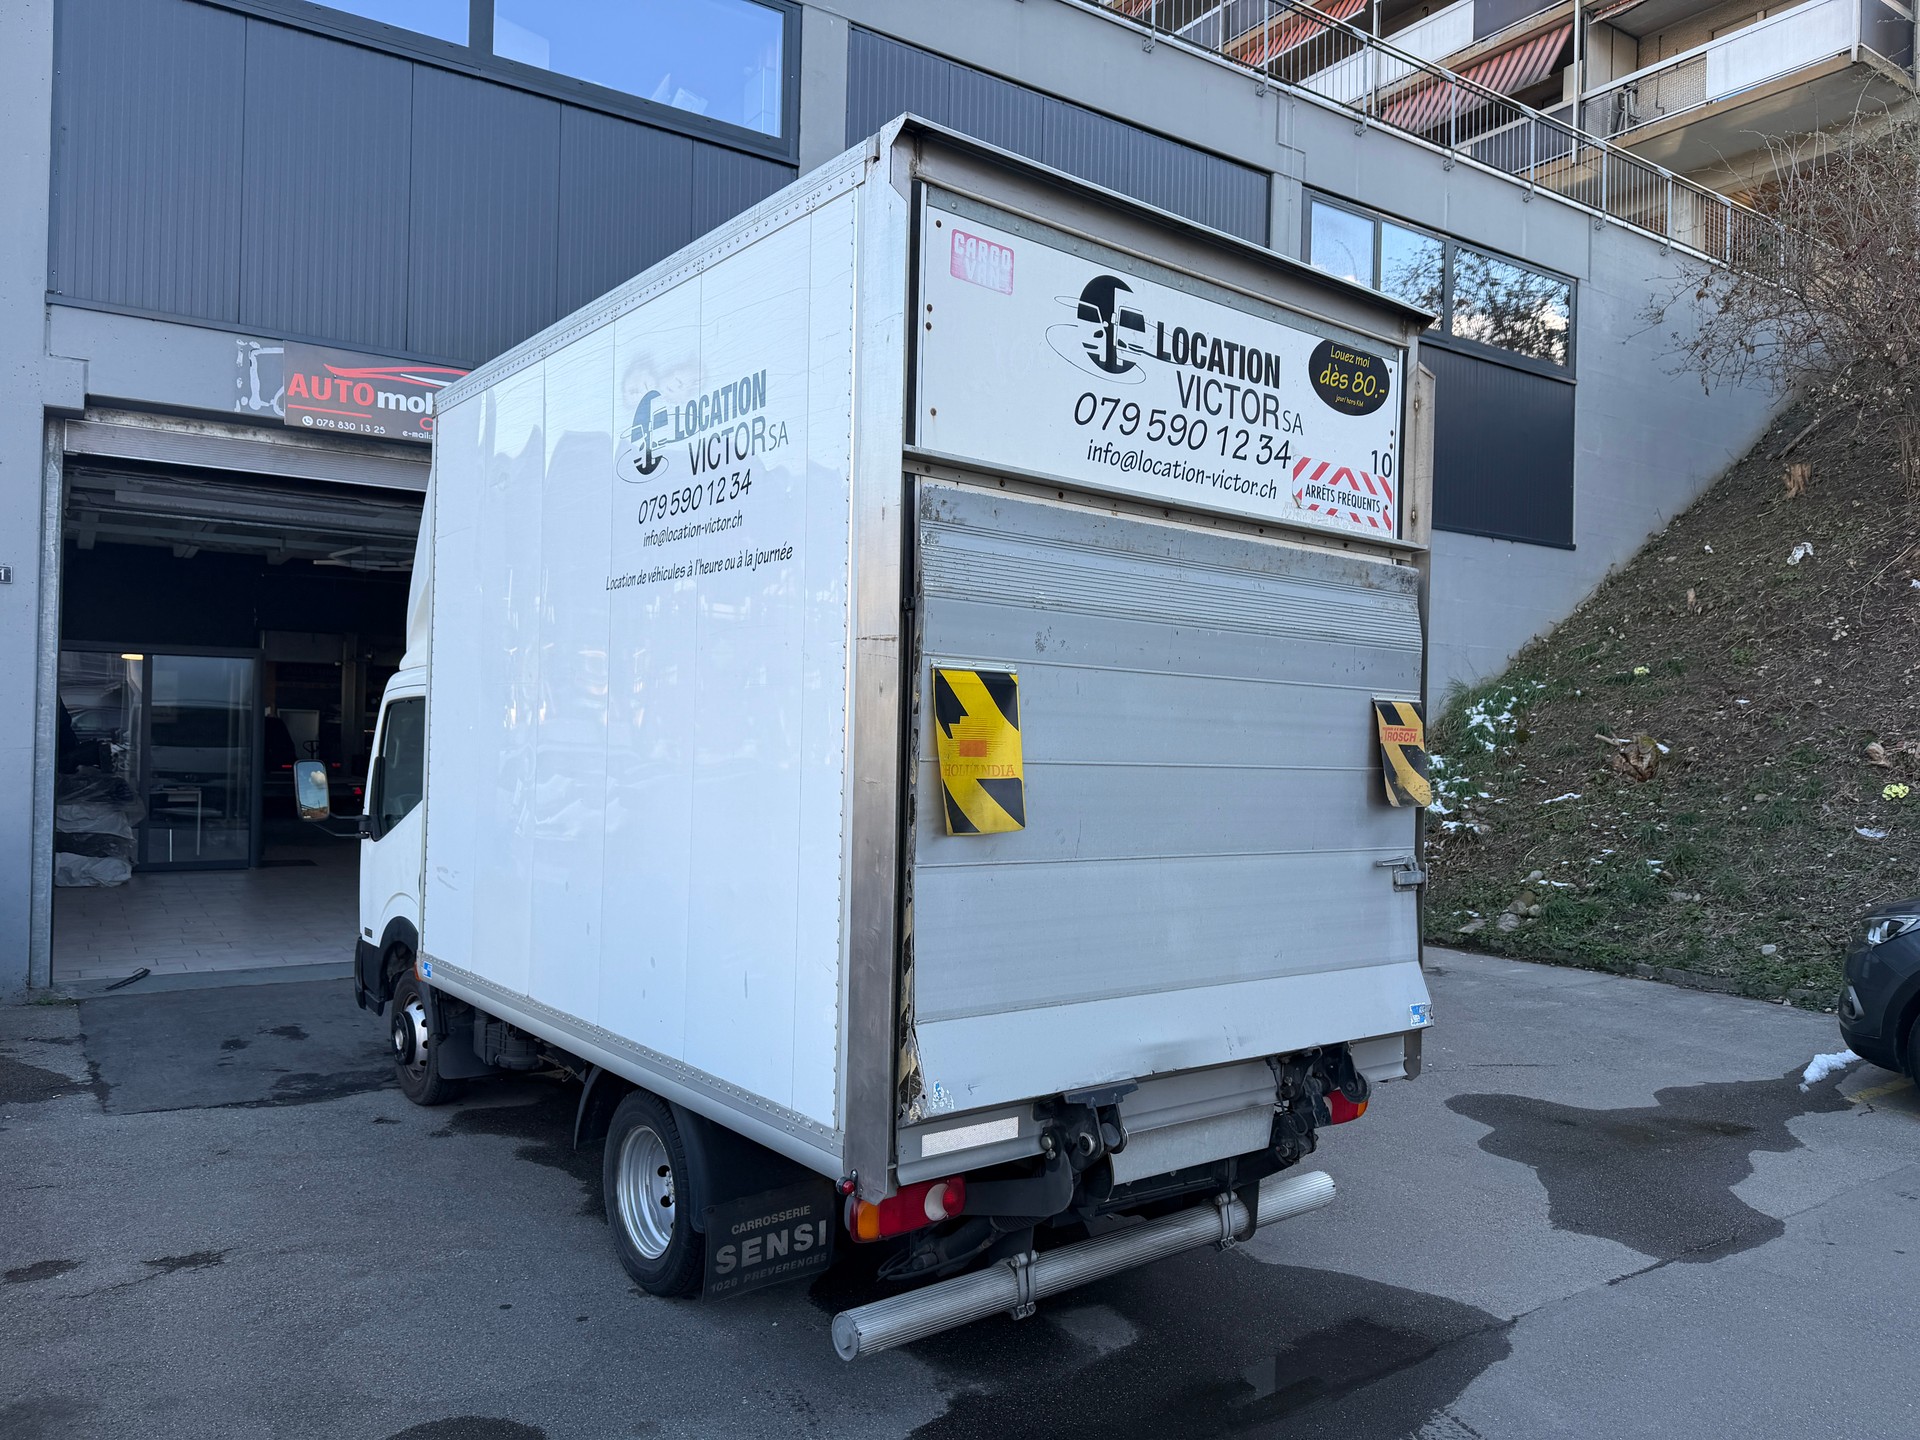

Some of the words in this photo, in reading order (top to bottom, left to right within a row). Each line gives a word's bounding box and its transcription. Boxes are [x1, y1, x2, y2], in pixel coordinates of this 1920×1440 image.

[954, 233, 1011, 270] CARGO
[1156, 320, 1281, 389] LOCATION
[1330, 345, 1355, 364] Louez
[1355, 356, 1371, 368] moi
[1319, 363, 1349, 389] dès
[1351, 371, 1385, 399] 80.-
[674, 369, 767, 441] LOCATION
[1176, 371, 1280, 430] VICTOR
[1282, 410, 1304, 436] SA
[316, 418, 335, 428] 078
[337, 420, 356, 431] 830
[360, 423, 371, 433] 13
[373, 425, 386, 434] 25
[688, 415, 767, 476] VICTOR
[768, 421, 789, 452] SA
[1073, 392, 1141, 436] 079
[1146, 409, 1208, 451] 590
[1216, 425, 1250, 461] 12
[1256, 433, 1292, 469] 34
[1087, 439, 1278, 500] info@location-victor.ch
[1371, 450, 1393, 478] 10
[638, 494, 667, 525] 079
[669, 484, 703, 516] 590
[706, 476, 726, 506] 12
[729, 468, 752, 500] 34
[1305, 483, 1336, 503] ARRÊTS
[1337, 490, 1381, 513] FRÉQUENTS
[643, 510, 743, 547] info@location-victor.ch
[605, 575, 636, 591] Location
[636, 569, 647, 585] de
[647, 562, 686, 584] véhicules
[686, 560, 693, 577] à
[694, 559, 723, 576] l'heure
[724, 557, 736, 571] ou
[737, 551, 743, 568] à
[744, 549, 753, 567] la
[752, 541, 794, 572] journée
[731, 1205, 811, 1235] CARROSSERIE
[715, 1219, 827, 1275] SENSI
[743, 1252, 827, 1284] PREVERENGES
